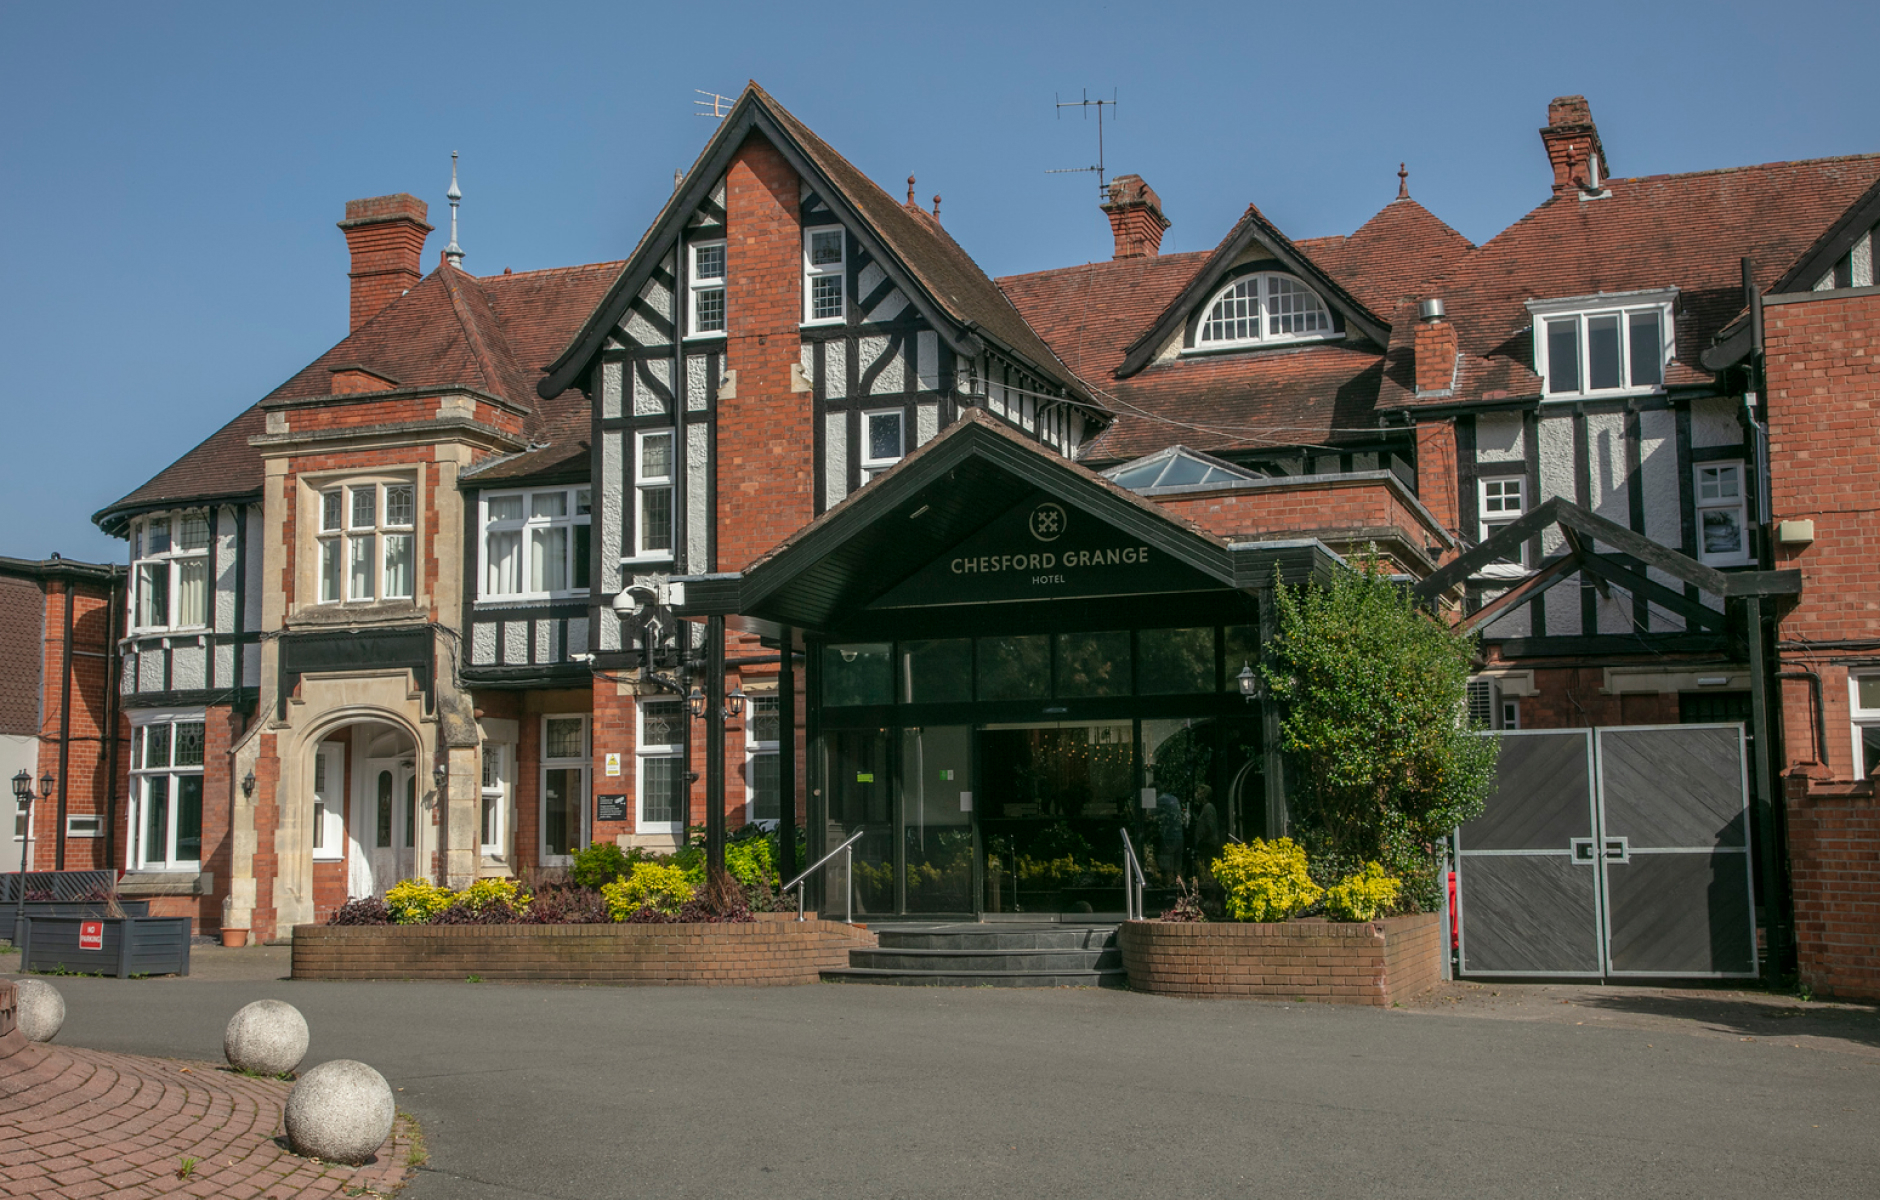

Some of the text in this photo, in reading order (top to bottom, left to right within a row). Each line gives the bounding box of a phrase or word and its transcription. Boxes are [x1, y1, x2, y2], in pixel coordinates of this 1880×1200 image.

[951, 547, 1149, 574] CHESFORD GRANGE
[1032, 574, 1066, 585] HOTEL
[87, 926, 95, 934] NO
[80, 935, 101, 943] PARKING
